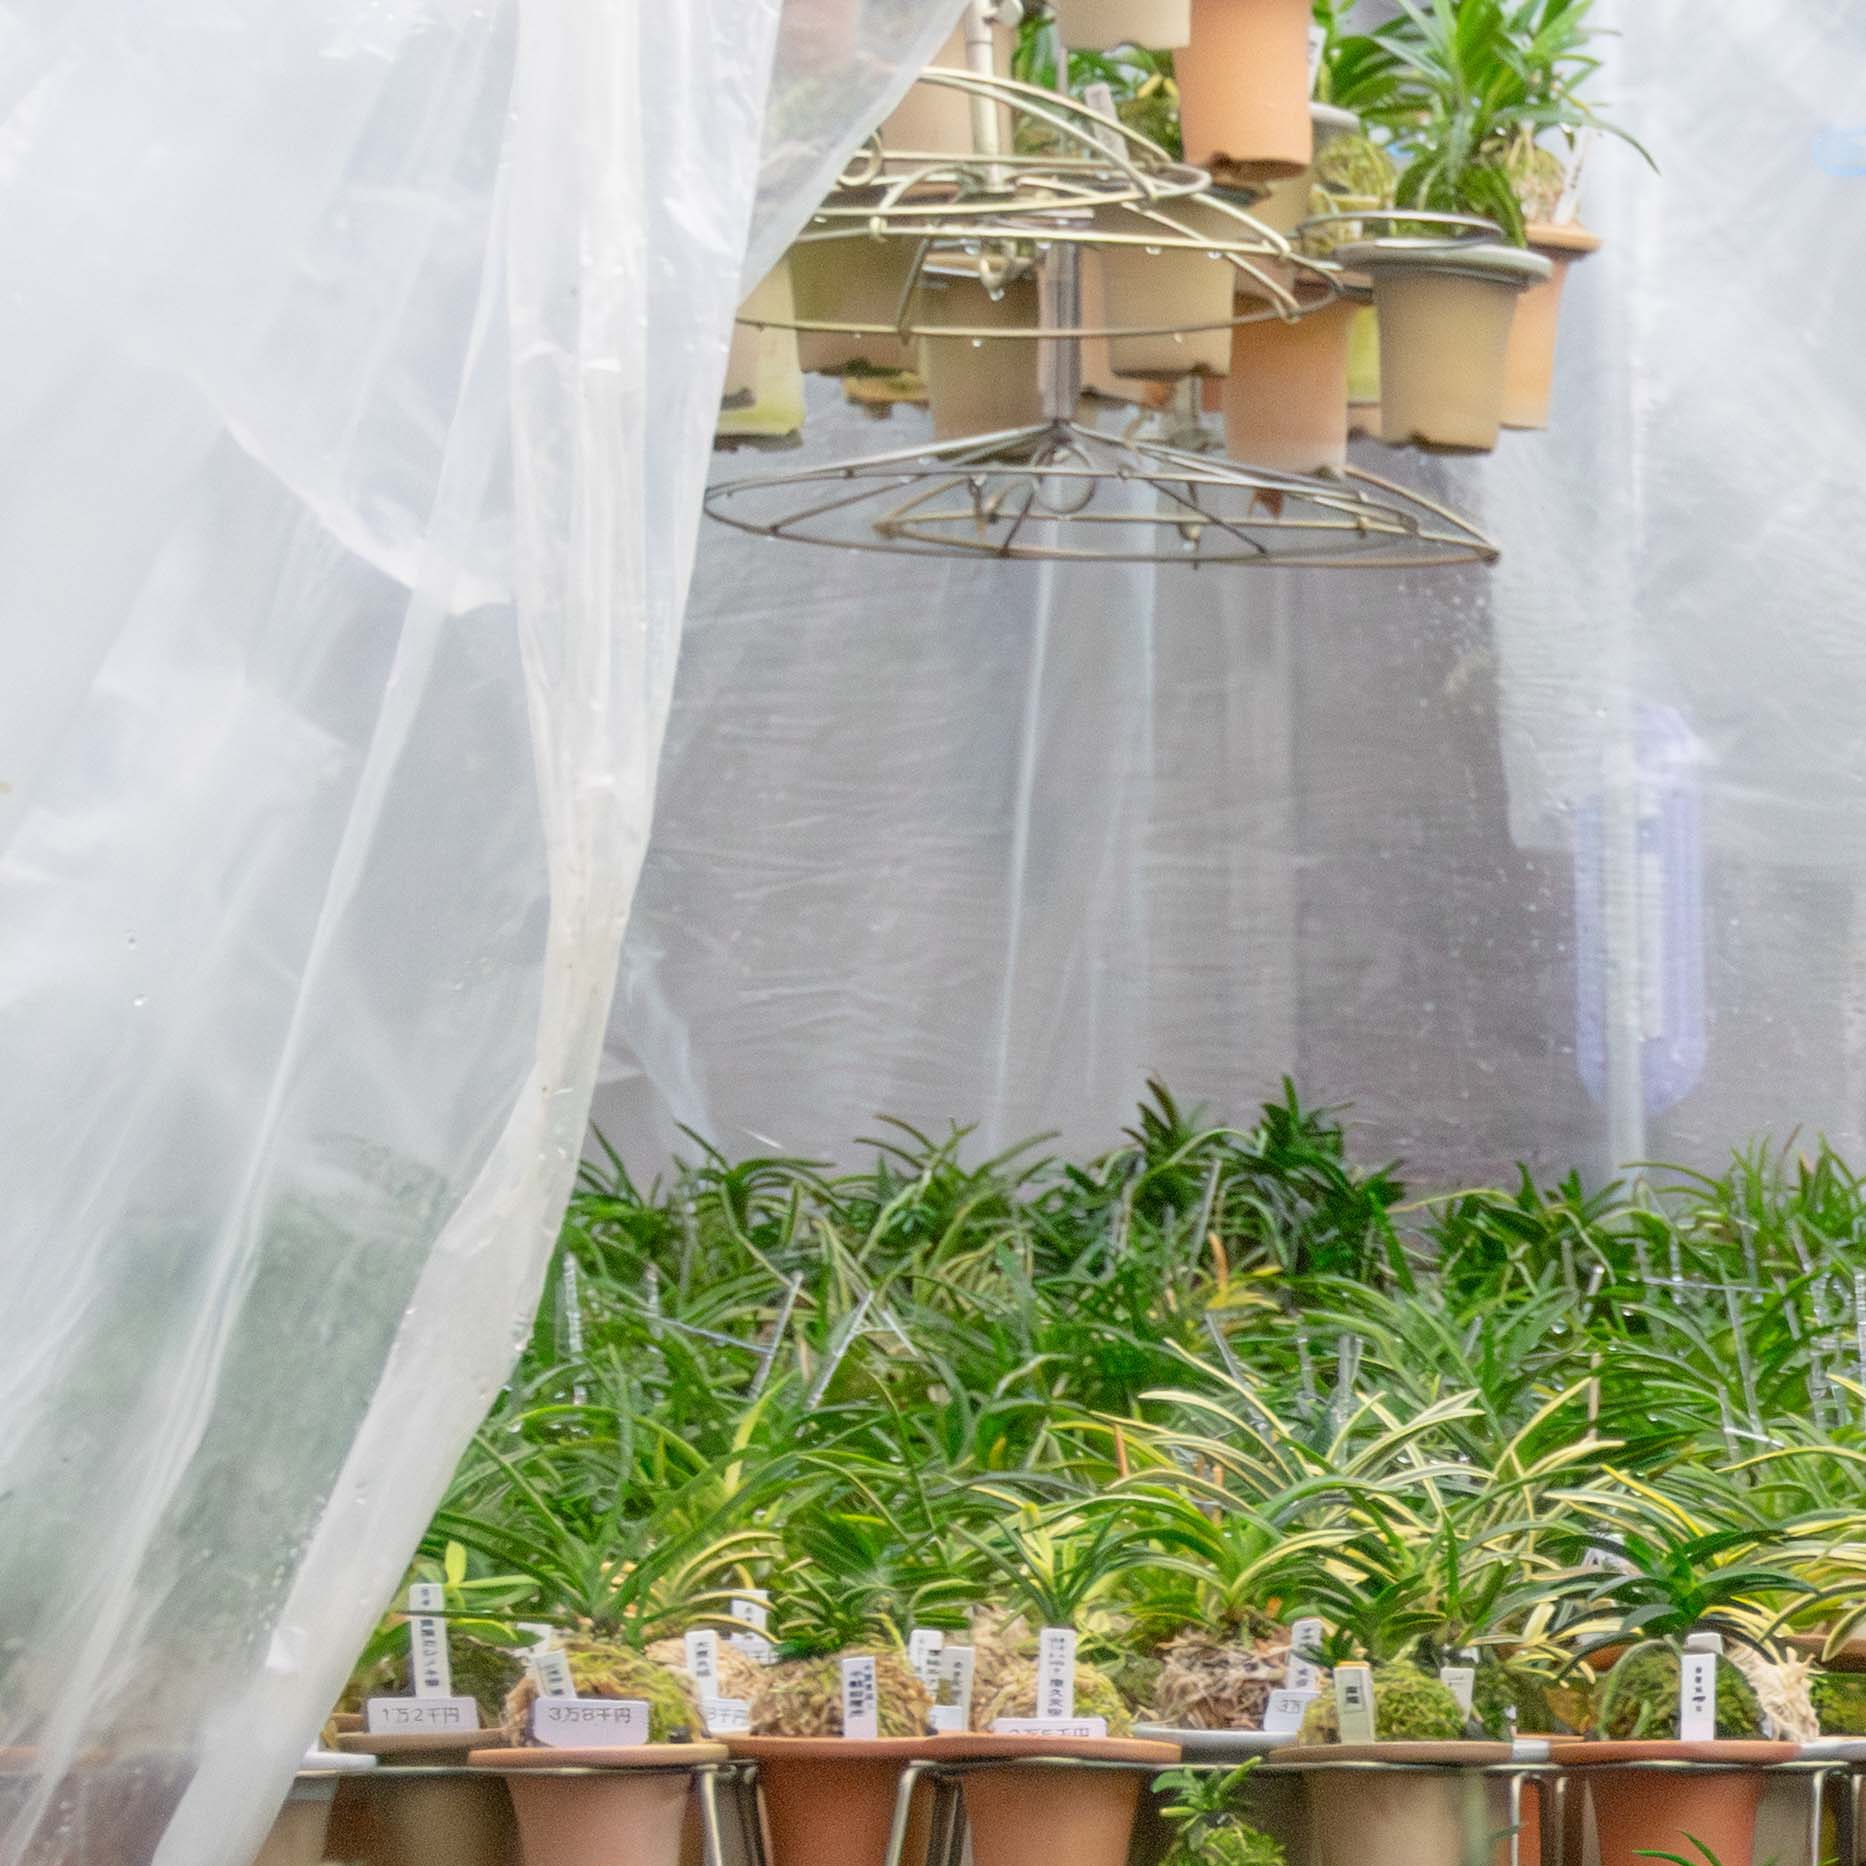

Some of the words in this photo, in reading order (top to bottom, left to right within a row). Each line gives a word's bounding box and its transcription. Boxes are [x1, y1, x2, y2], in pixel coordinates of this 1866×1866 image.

[382, 1707, 460, 1724] 1万2千円
[549, 1706, 632, 1724] 3万8千円
